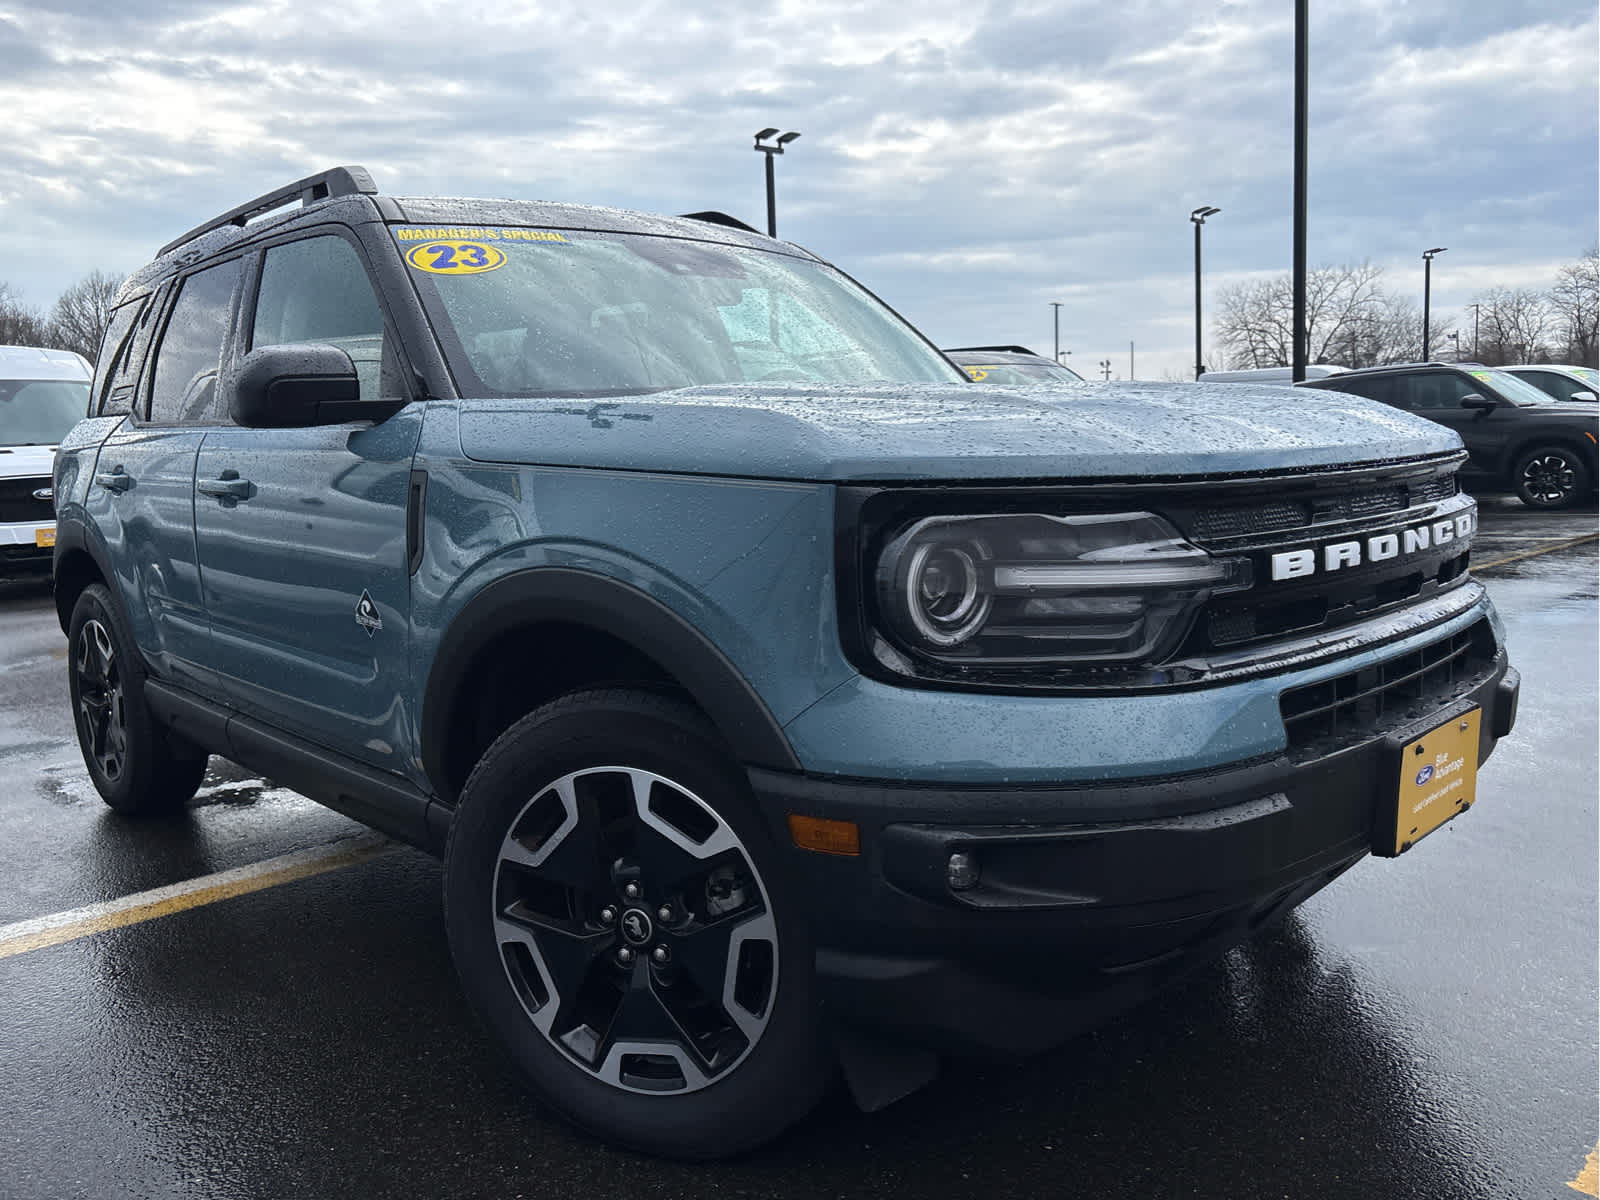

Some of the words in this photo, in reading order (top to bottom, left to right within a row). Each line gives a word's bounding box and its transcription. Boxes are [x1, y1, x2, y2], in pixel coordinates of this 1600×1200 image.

[397, 228, 499, 240] MANAGER'S
[501, 229, 570, 243] SPECIAL
[427, 245, 489, 269] 23
[1272, 514, 1472, 581] BRONCO
